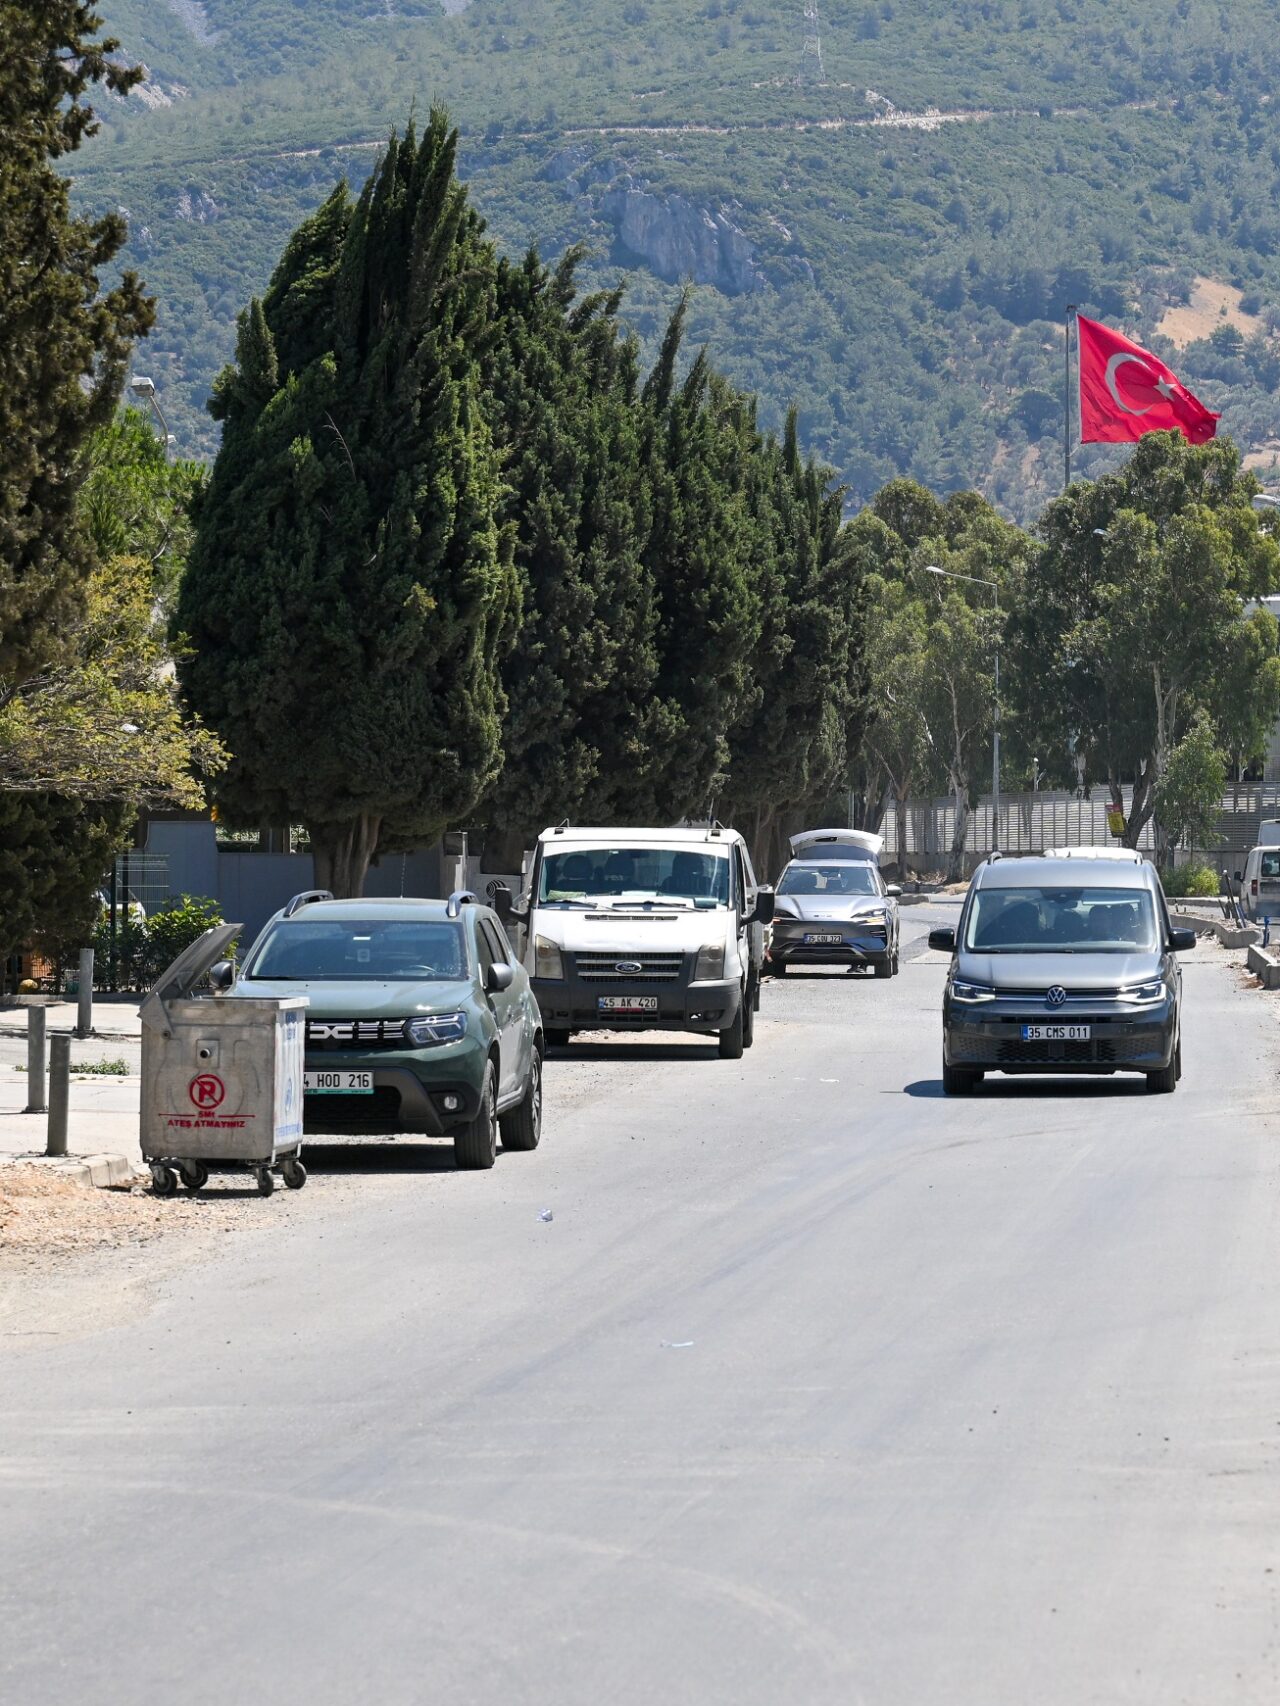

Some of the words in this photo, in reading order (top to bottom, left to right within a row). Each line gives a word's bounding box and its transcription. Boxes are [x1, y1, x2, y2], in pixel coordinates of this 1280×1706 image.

[604, 998, 615, 1007] 45
[621, 998, 632, 1007] AK
[639, 998, 656, 1008] 420
[1029, 1027, 1041, 1038] 35
[1046, 1027, 1065, 1038] CMS
[1069, 1027, 1087, 1038] 011
[317, 1074, 340, 1088] HOD
[348, 1074, 370, 1088] 216
[167, 1119, 192, 1128] ATEŞ
